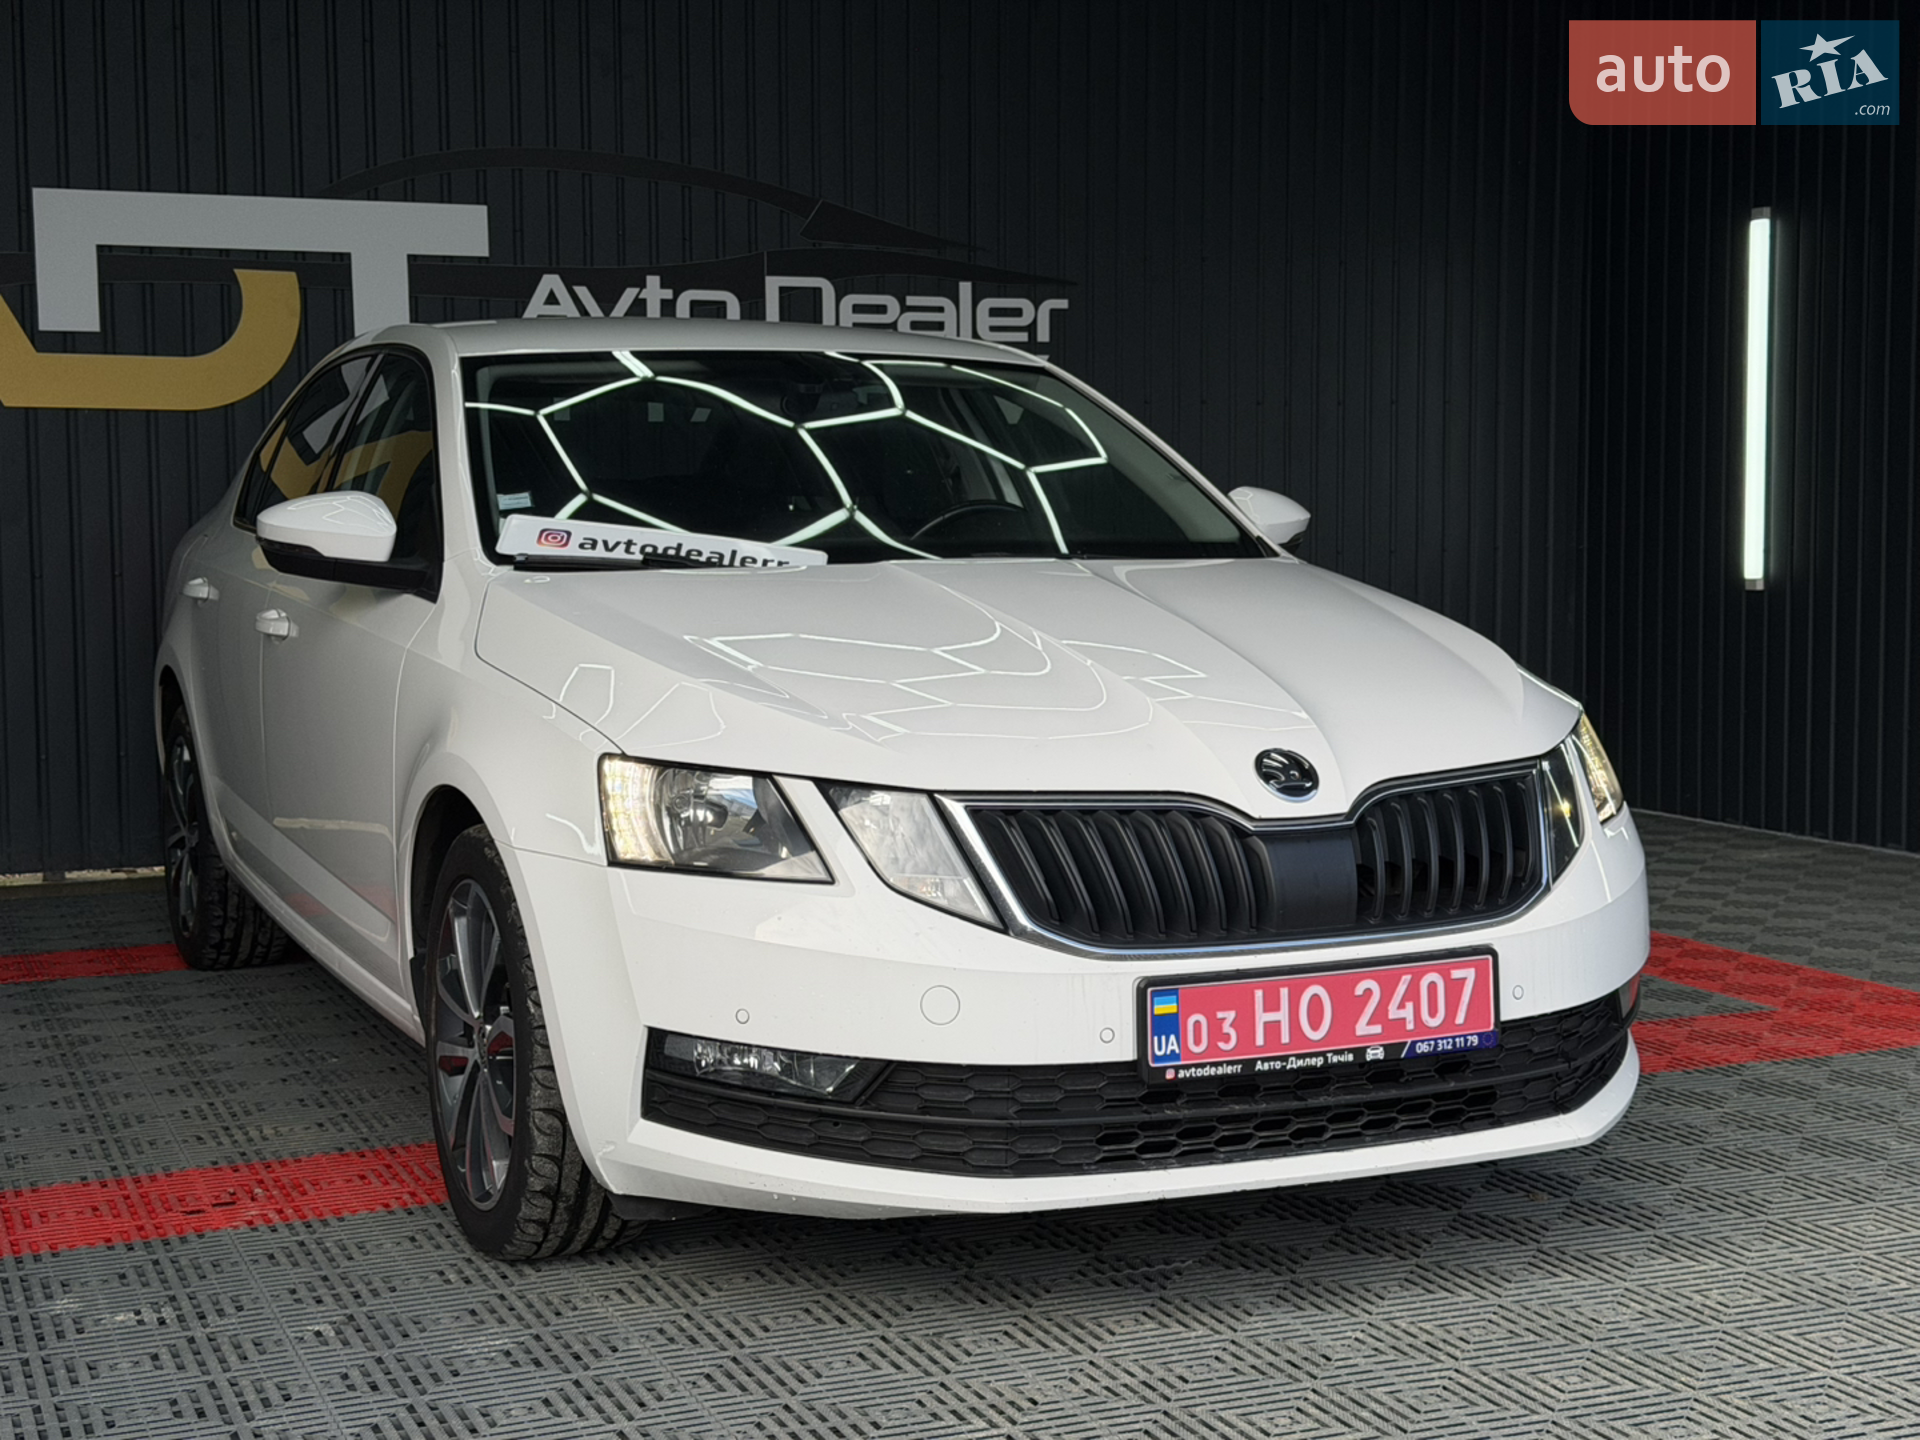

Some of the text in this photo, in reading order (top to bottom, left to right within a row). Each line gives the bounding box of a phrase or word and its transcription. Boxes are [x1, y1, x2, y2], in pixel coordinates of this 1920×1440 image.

[522, 274, 1069, 343] Avto Dealer
[1186, 1010, 1238, 1054] 03
[1353, 967, 1477, 1037] 2407
[1153, 1034, 1180, 1056] UA
[1415, 1041, 1434, 1054] 067
[1437, 1039, 1453, 1051] 312
[1466, 1034, 1479, 1047] 79
[1177, 1064, 1243, 1079] avtodealerr
[1255, 1055, 1325, 1072] Авто-Дилер
